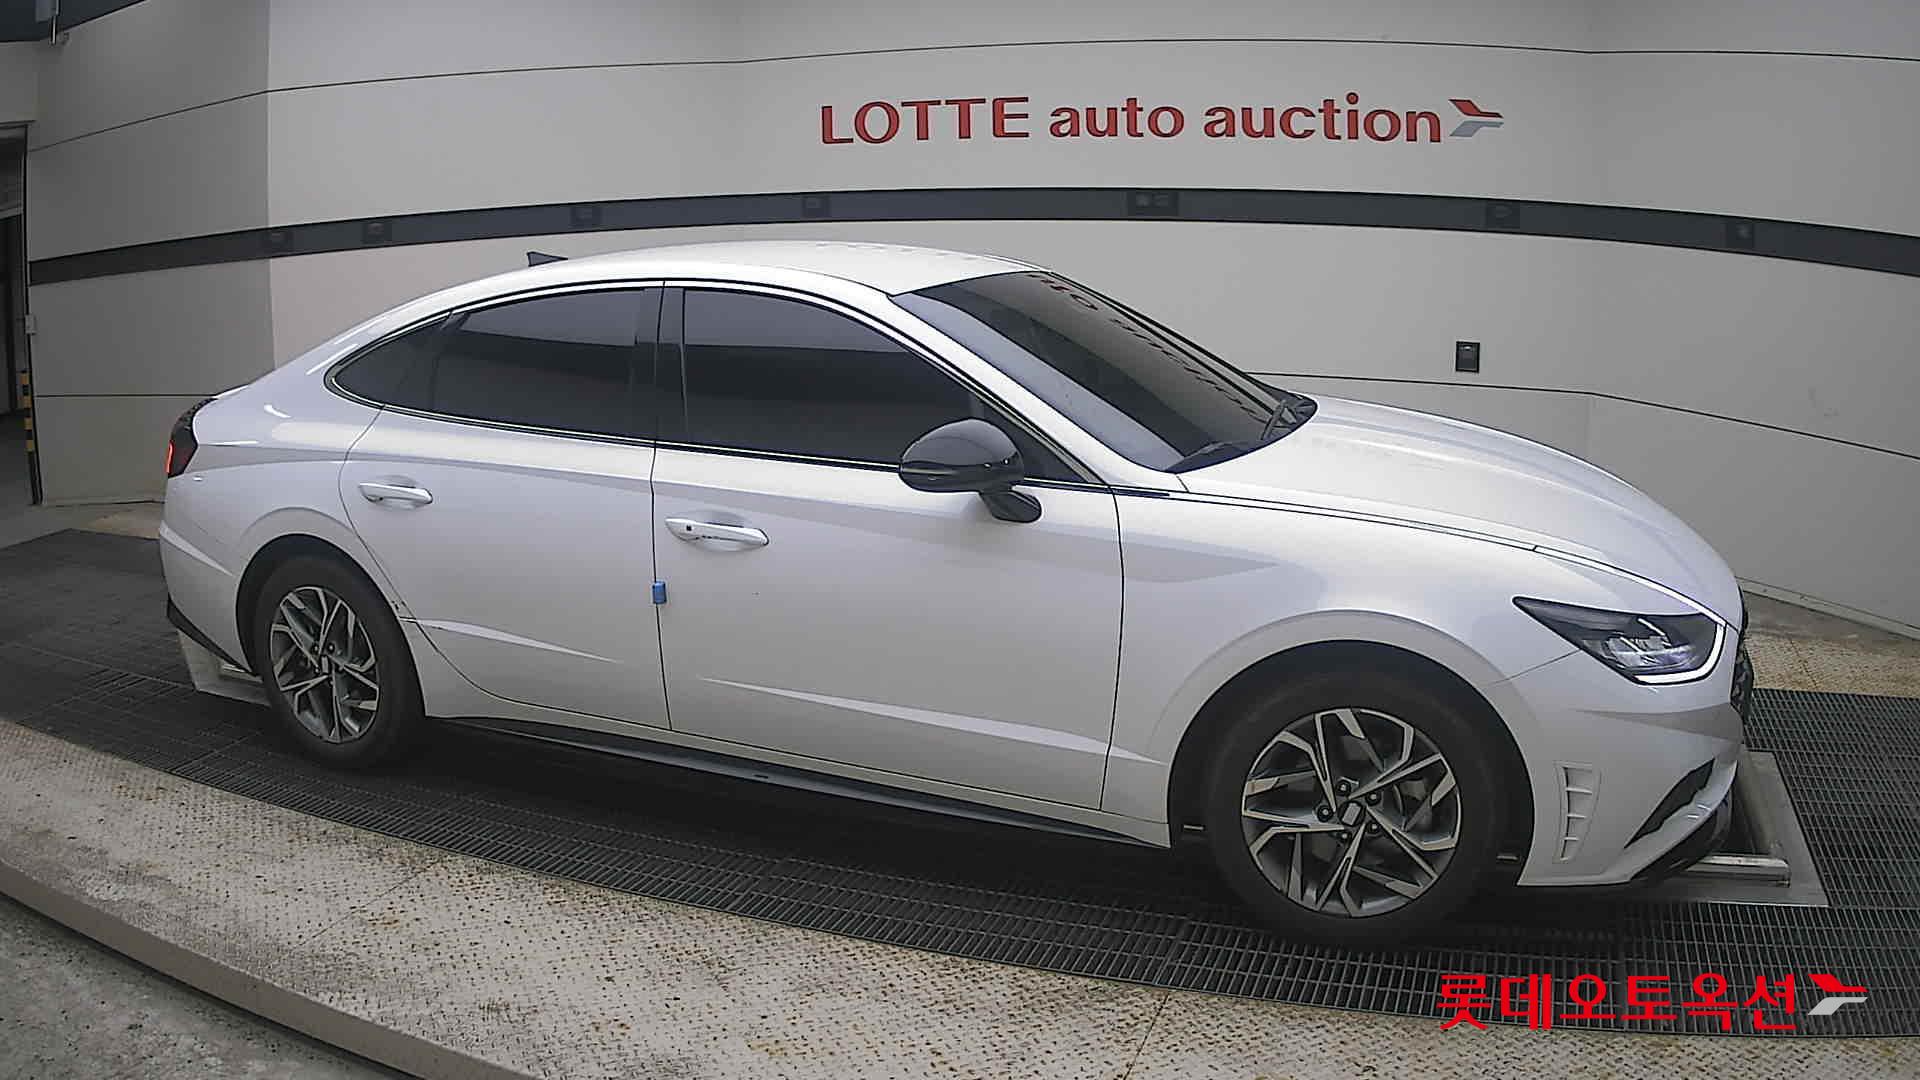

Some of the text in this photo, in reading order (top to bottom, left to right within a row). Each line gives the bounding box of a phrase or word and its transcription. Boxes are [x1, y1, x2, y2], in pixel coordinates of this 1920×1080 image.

[821, 92, 1442, 145] LOTTE auto auction
